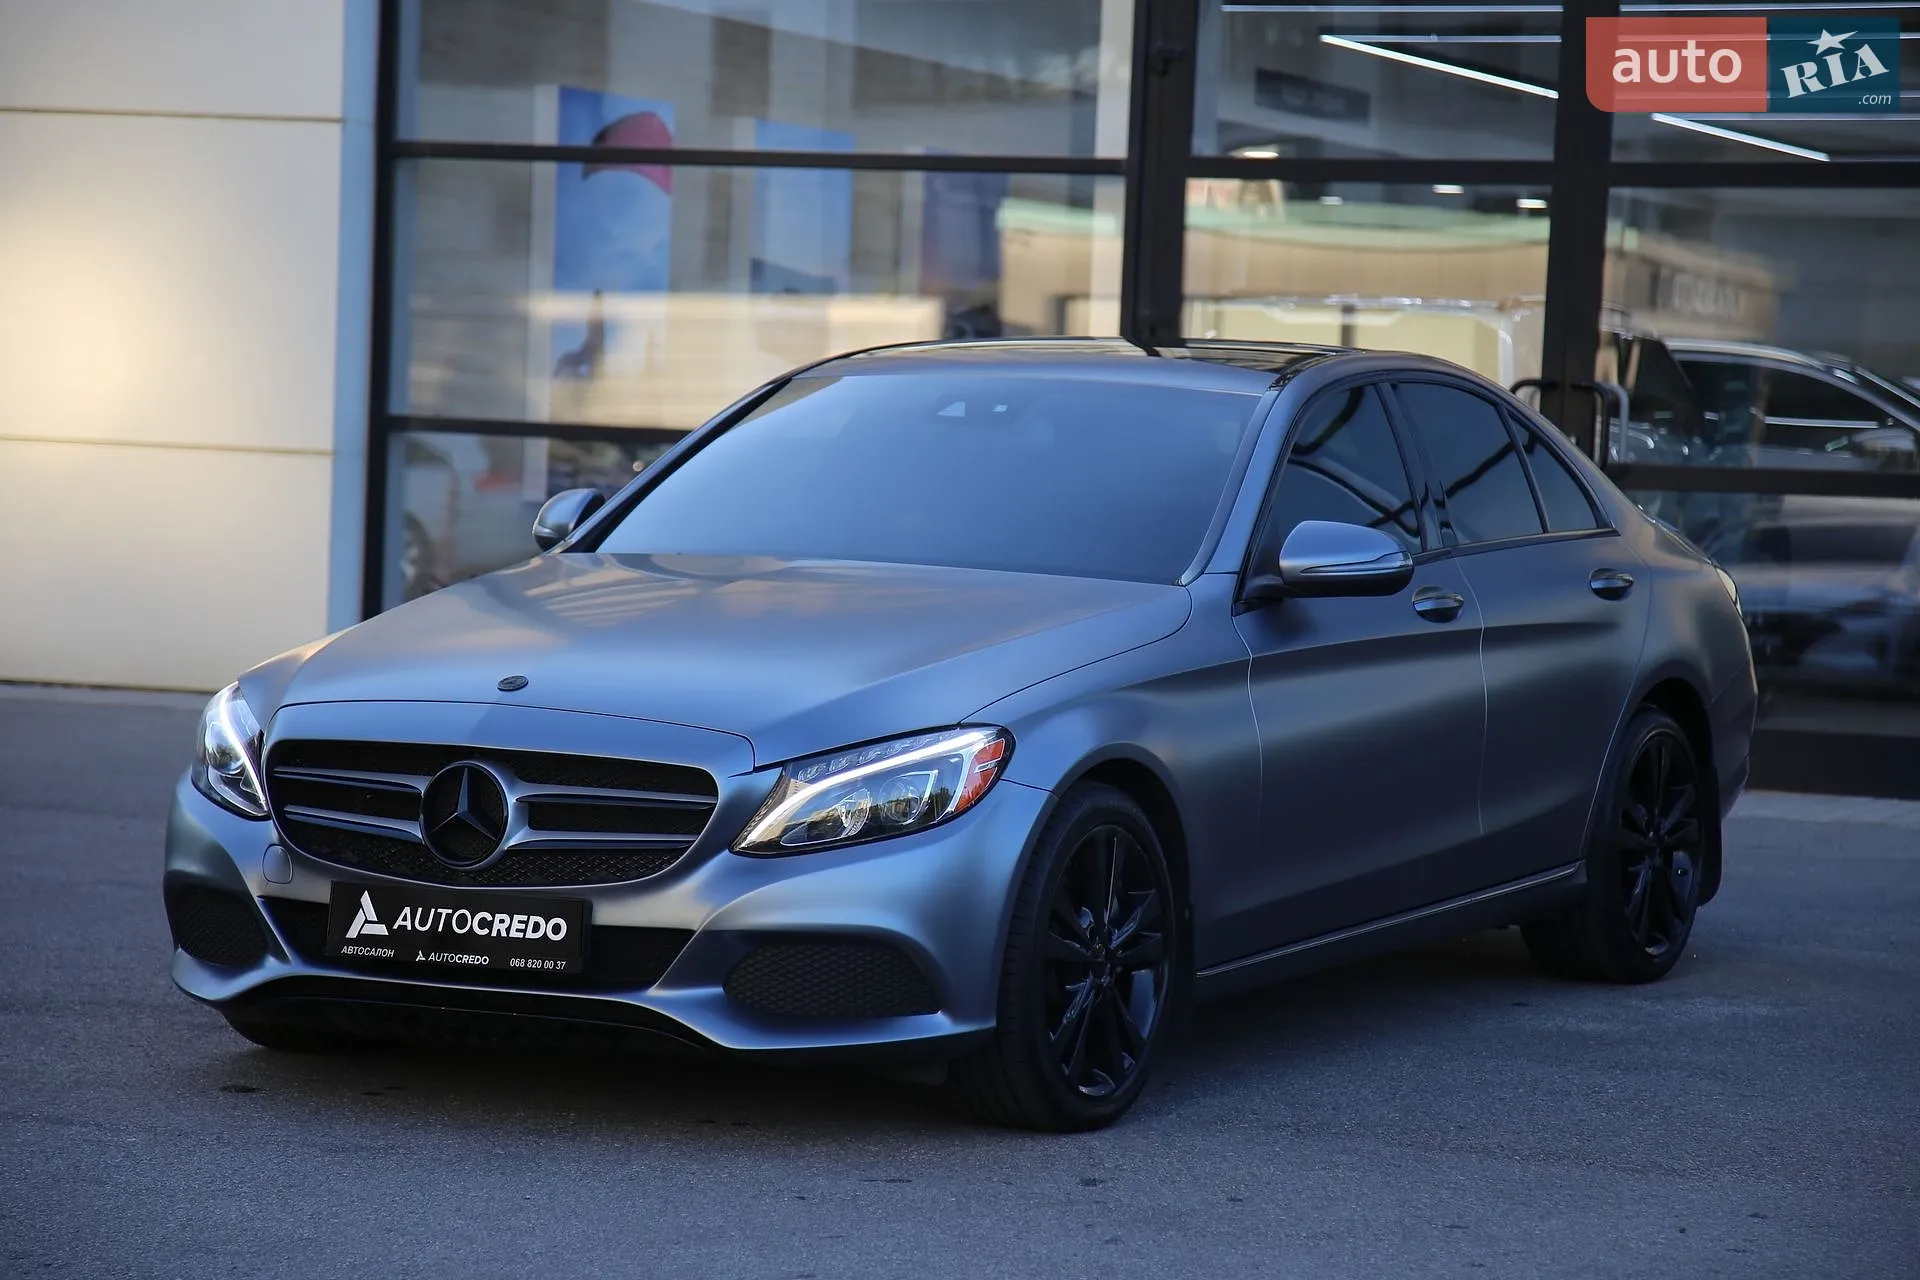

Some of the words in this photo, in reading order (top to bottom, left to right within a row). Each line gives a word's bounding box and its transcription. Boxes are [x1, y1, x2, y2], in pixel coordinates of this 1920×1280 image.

[393, 906, 568, 941] AUTOCREDO
[341, 945, 395, 958] АВТОСАЛОН
[428, 952, 490, 965] AUTOCREDO
[509, 958, 525, 968] 068
[526, 959, 543, 969] 820
[543, 960, 555, 970] 00
[555, 960, 566, 970] 37
